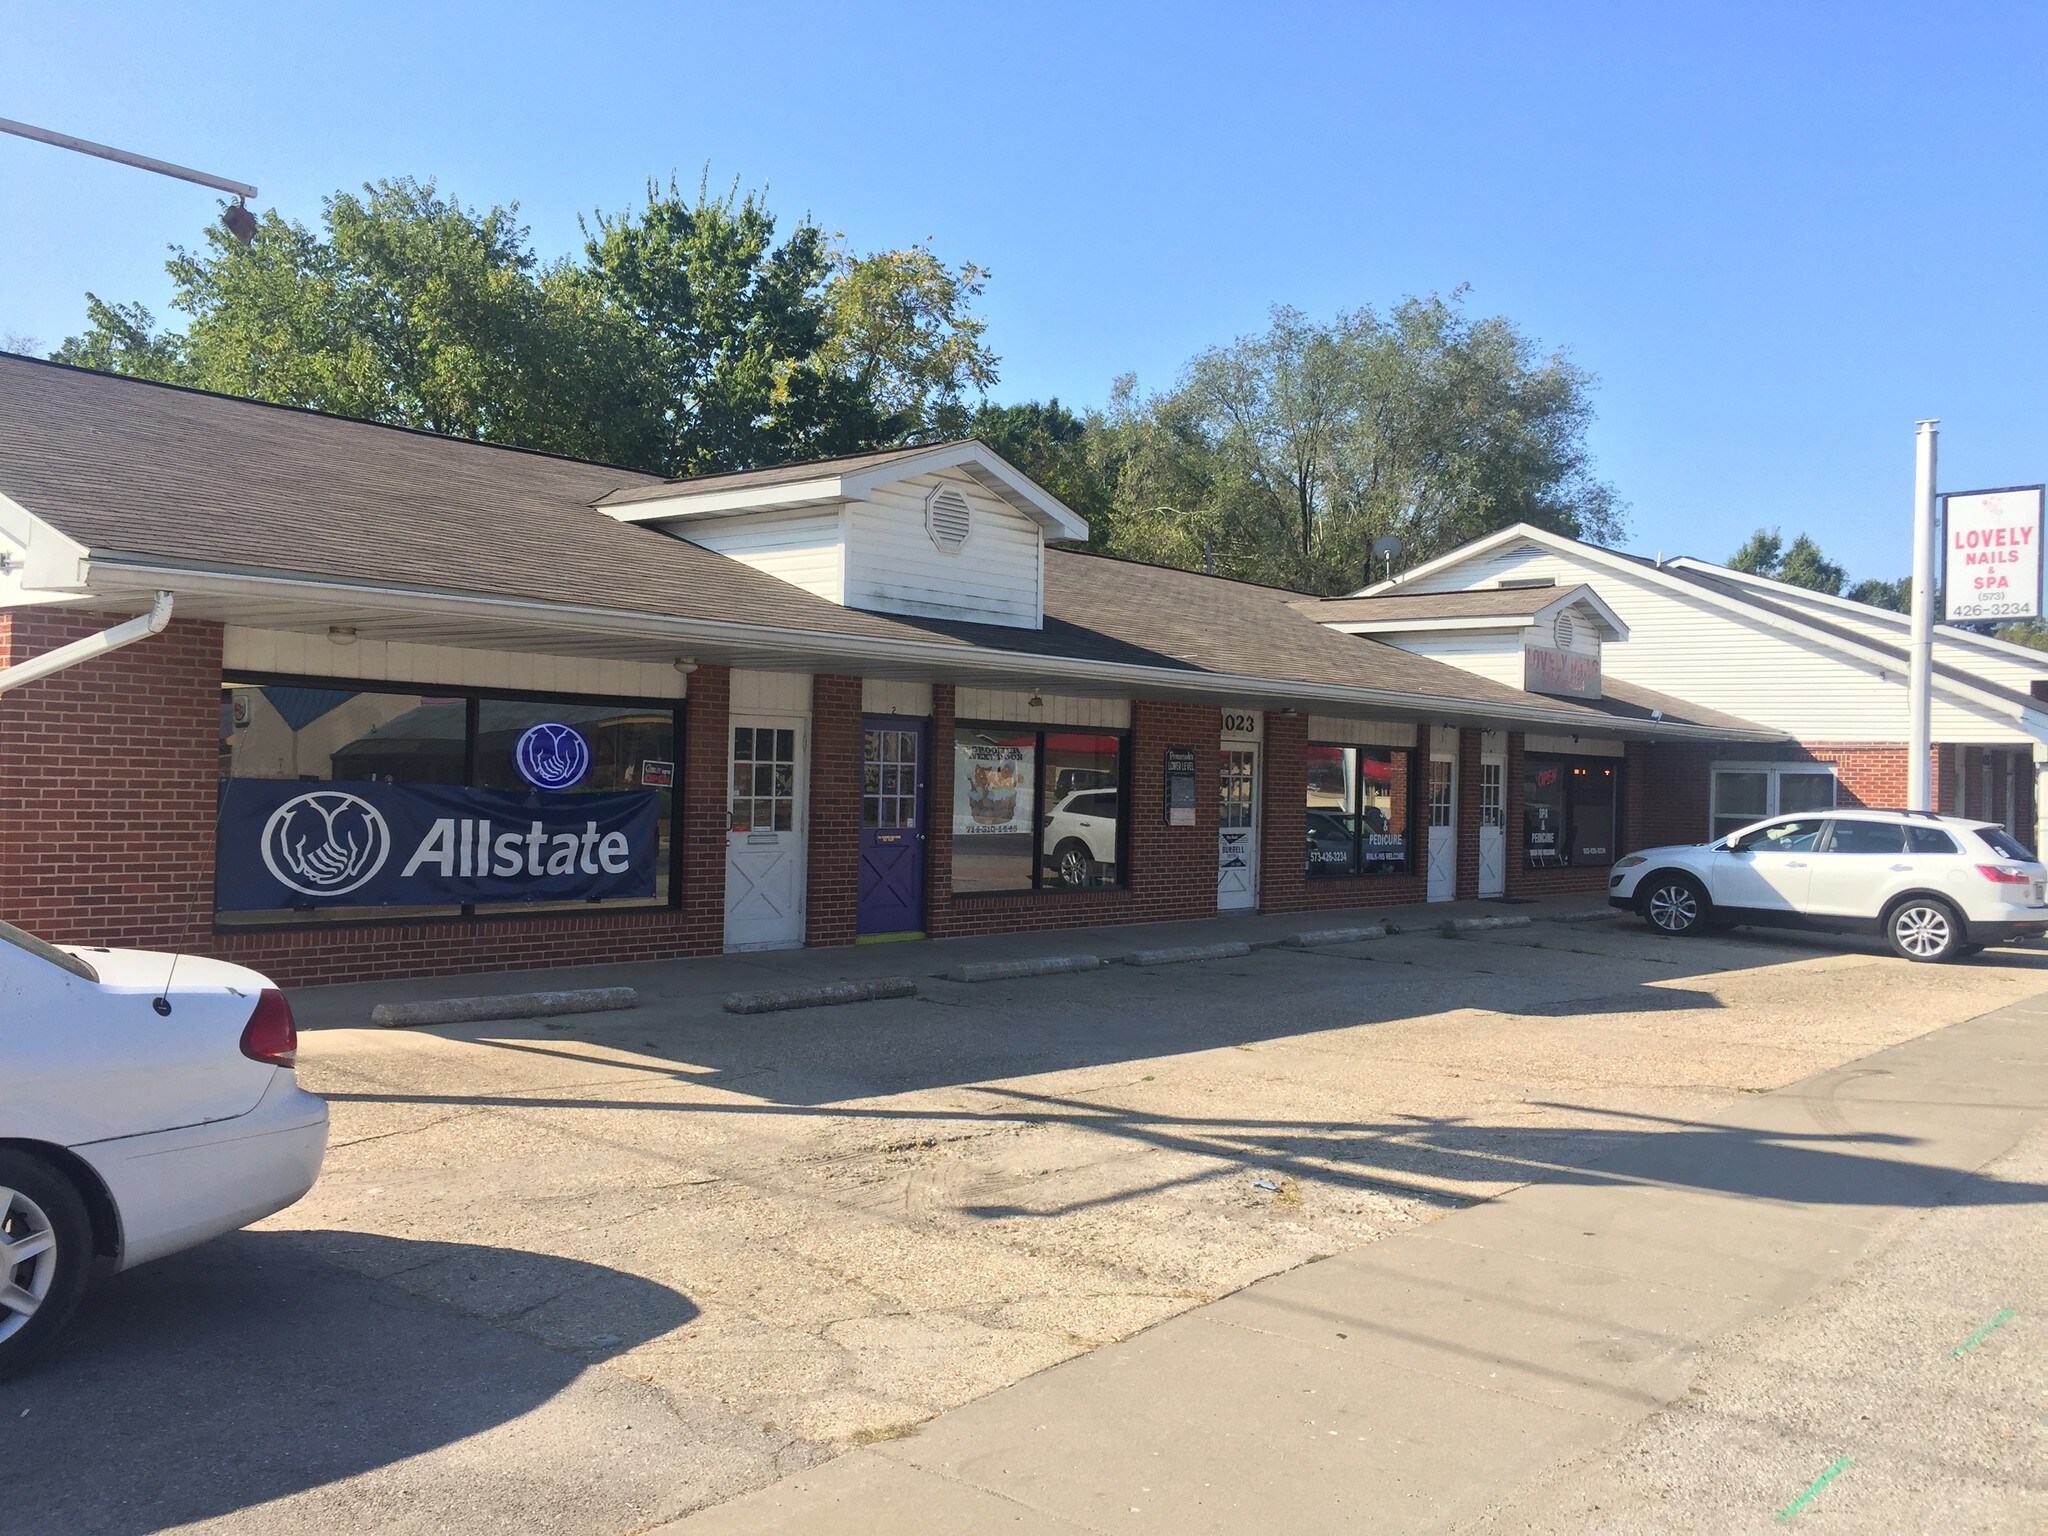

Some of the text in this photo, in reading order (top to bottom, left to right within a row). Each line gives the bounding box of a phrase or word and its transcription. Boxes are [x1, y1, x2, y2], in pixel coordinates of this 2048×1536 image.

[1954, 526, 2034, 550] LOVELY
[1965, 550, 2020, 566] NAILS
[1987, 566, 1995, 574] &
[1973, 575, 2009, 590] SPA
[1978, 592, 2005, 602] (573)
[1953, 602, 2031, 617] 426-3234
[1369, 834, 1402, 845] PEDICURE
[400, 818, 630, 877] Allstate
